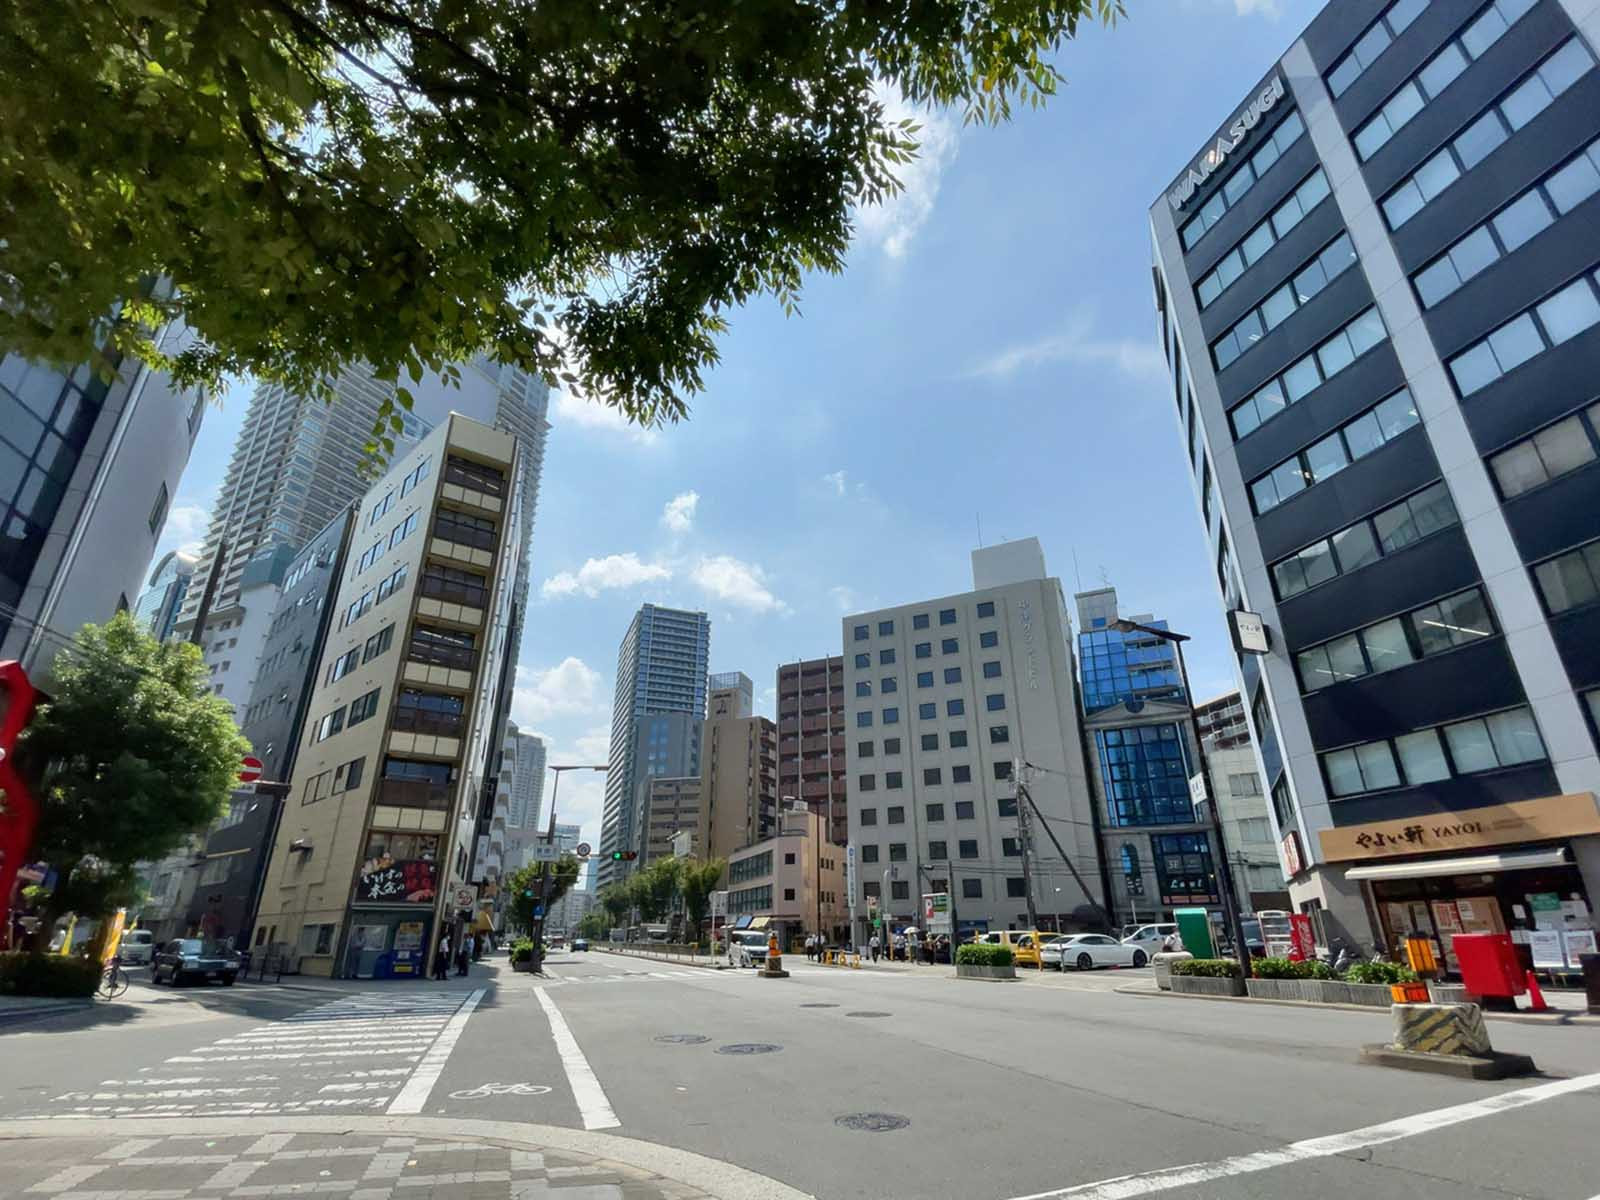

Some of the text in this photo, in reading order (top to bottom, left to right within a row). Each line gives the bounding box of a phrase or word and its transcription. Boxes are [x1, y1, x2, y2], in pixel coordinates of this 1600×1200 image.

[1168, 76, 1284, 209] WAKASUGI
[1355, 825, 1424, 849] やよい軒
[1432, 821, 1483, 838] YAYOI
